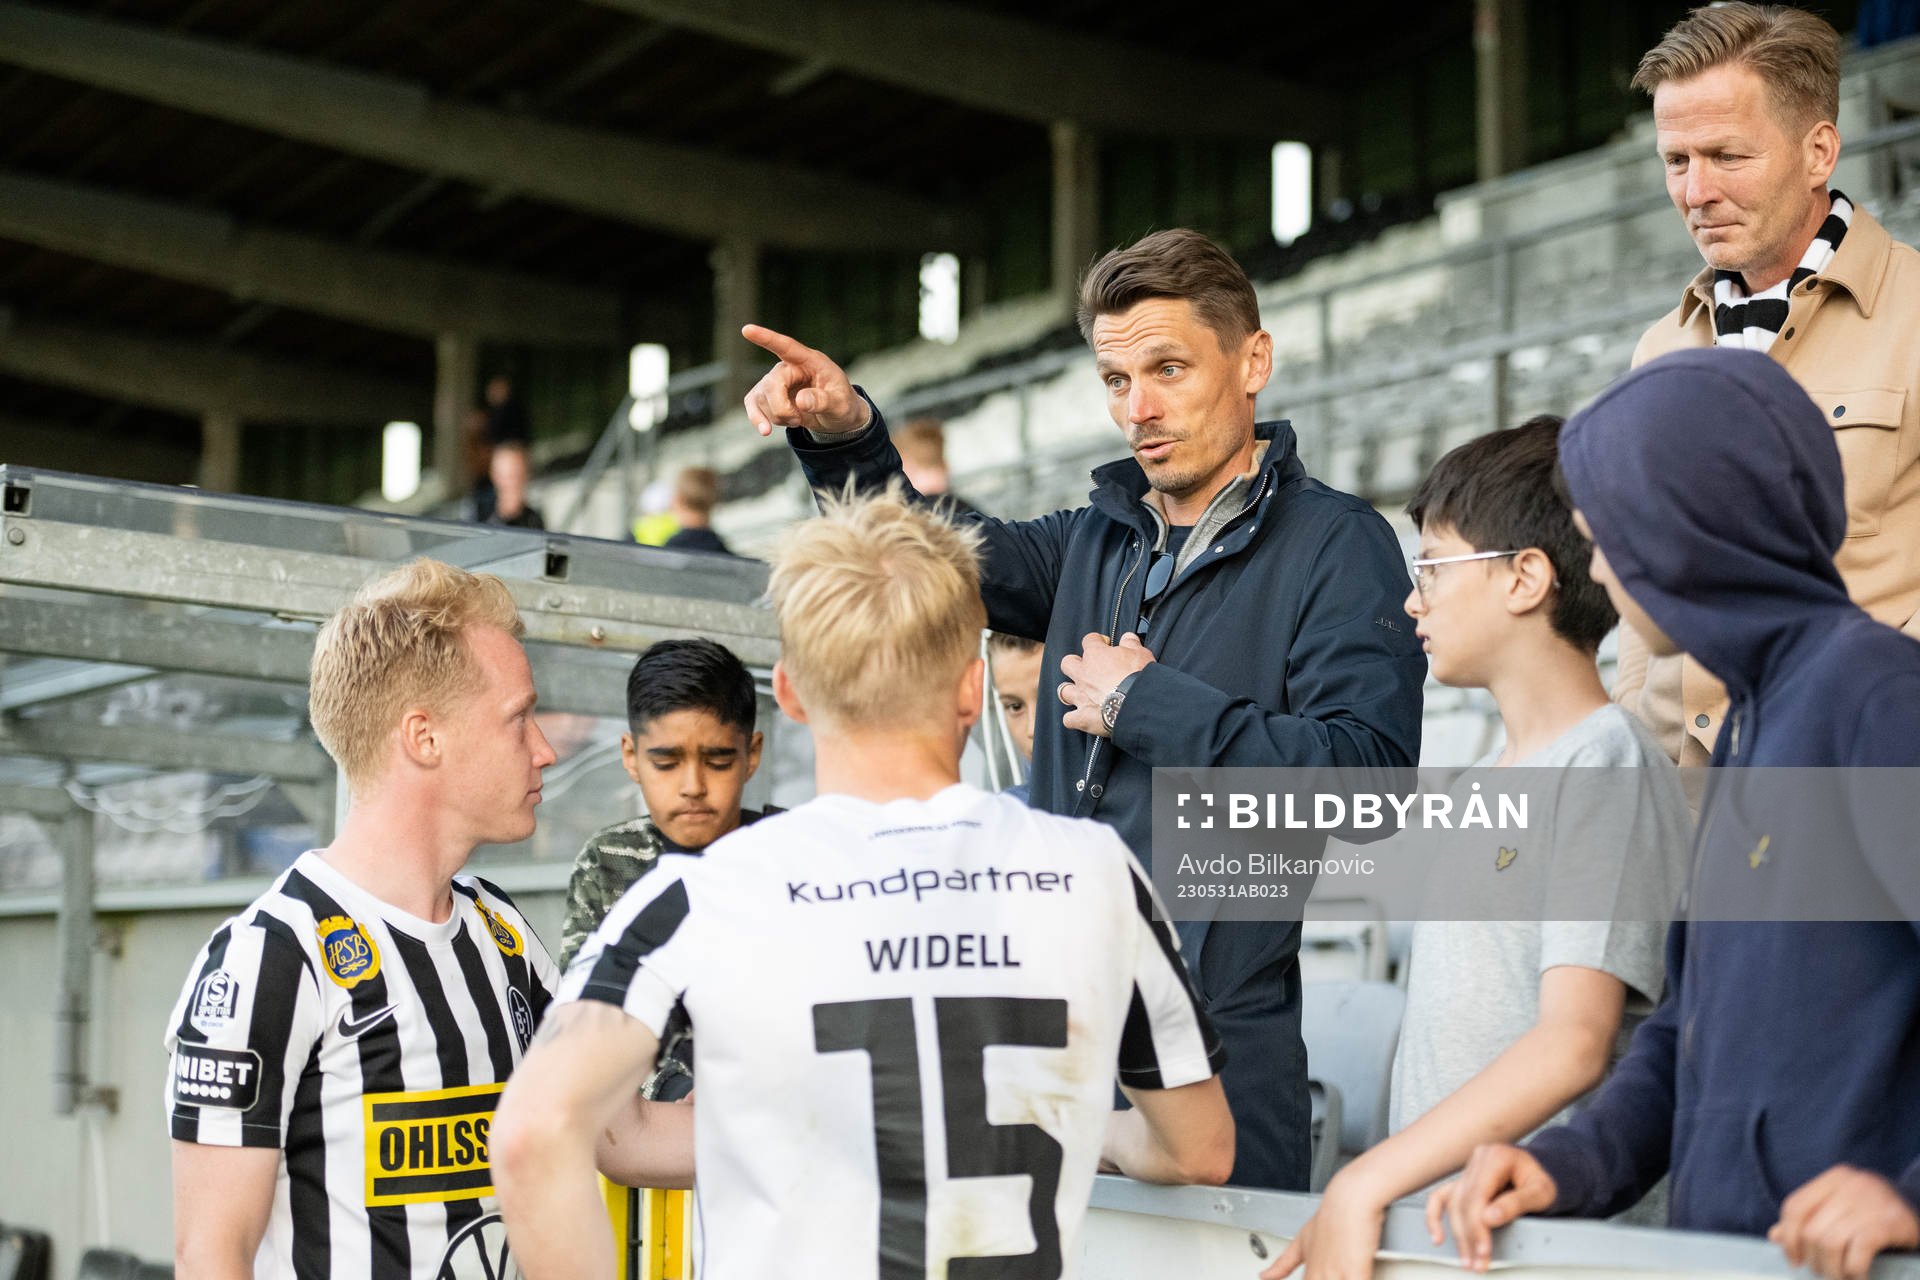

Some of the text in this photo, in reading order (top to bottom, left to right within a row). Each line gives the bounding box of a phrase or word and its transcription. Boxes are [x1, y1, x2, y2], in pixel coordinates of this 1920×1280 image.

[786, 867, 1074, 903] Kundpartner
[328, 934, 368, 969] HSB
[865, 933, 1021, 972] WIDELL
[379, 1117, 490, 1172] OHLSS
[812, 996, 1069, 1280] 15
